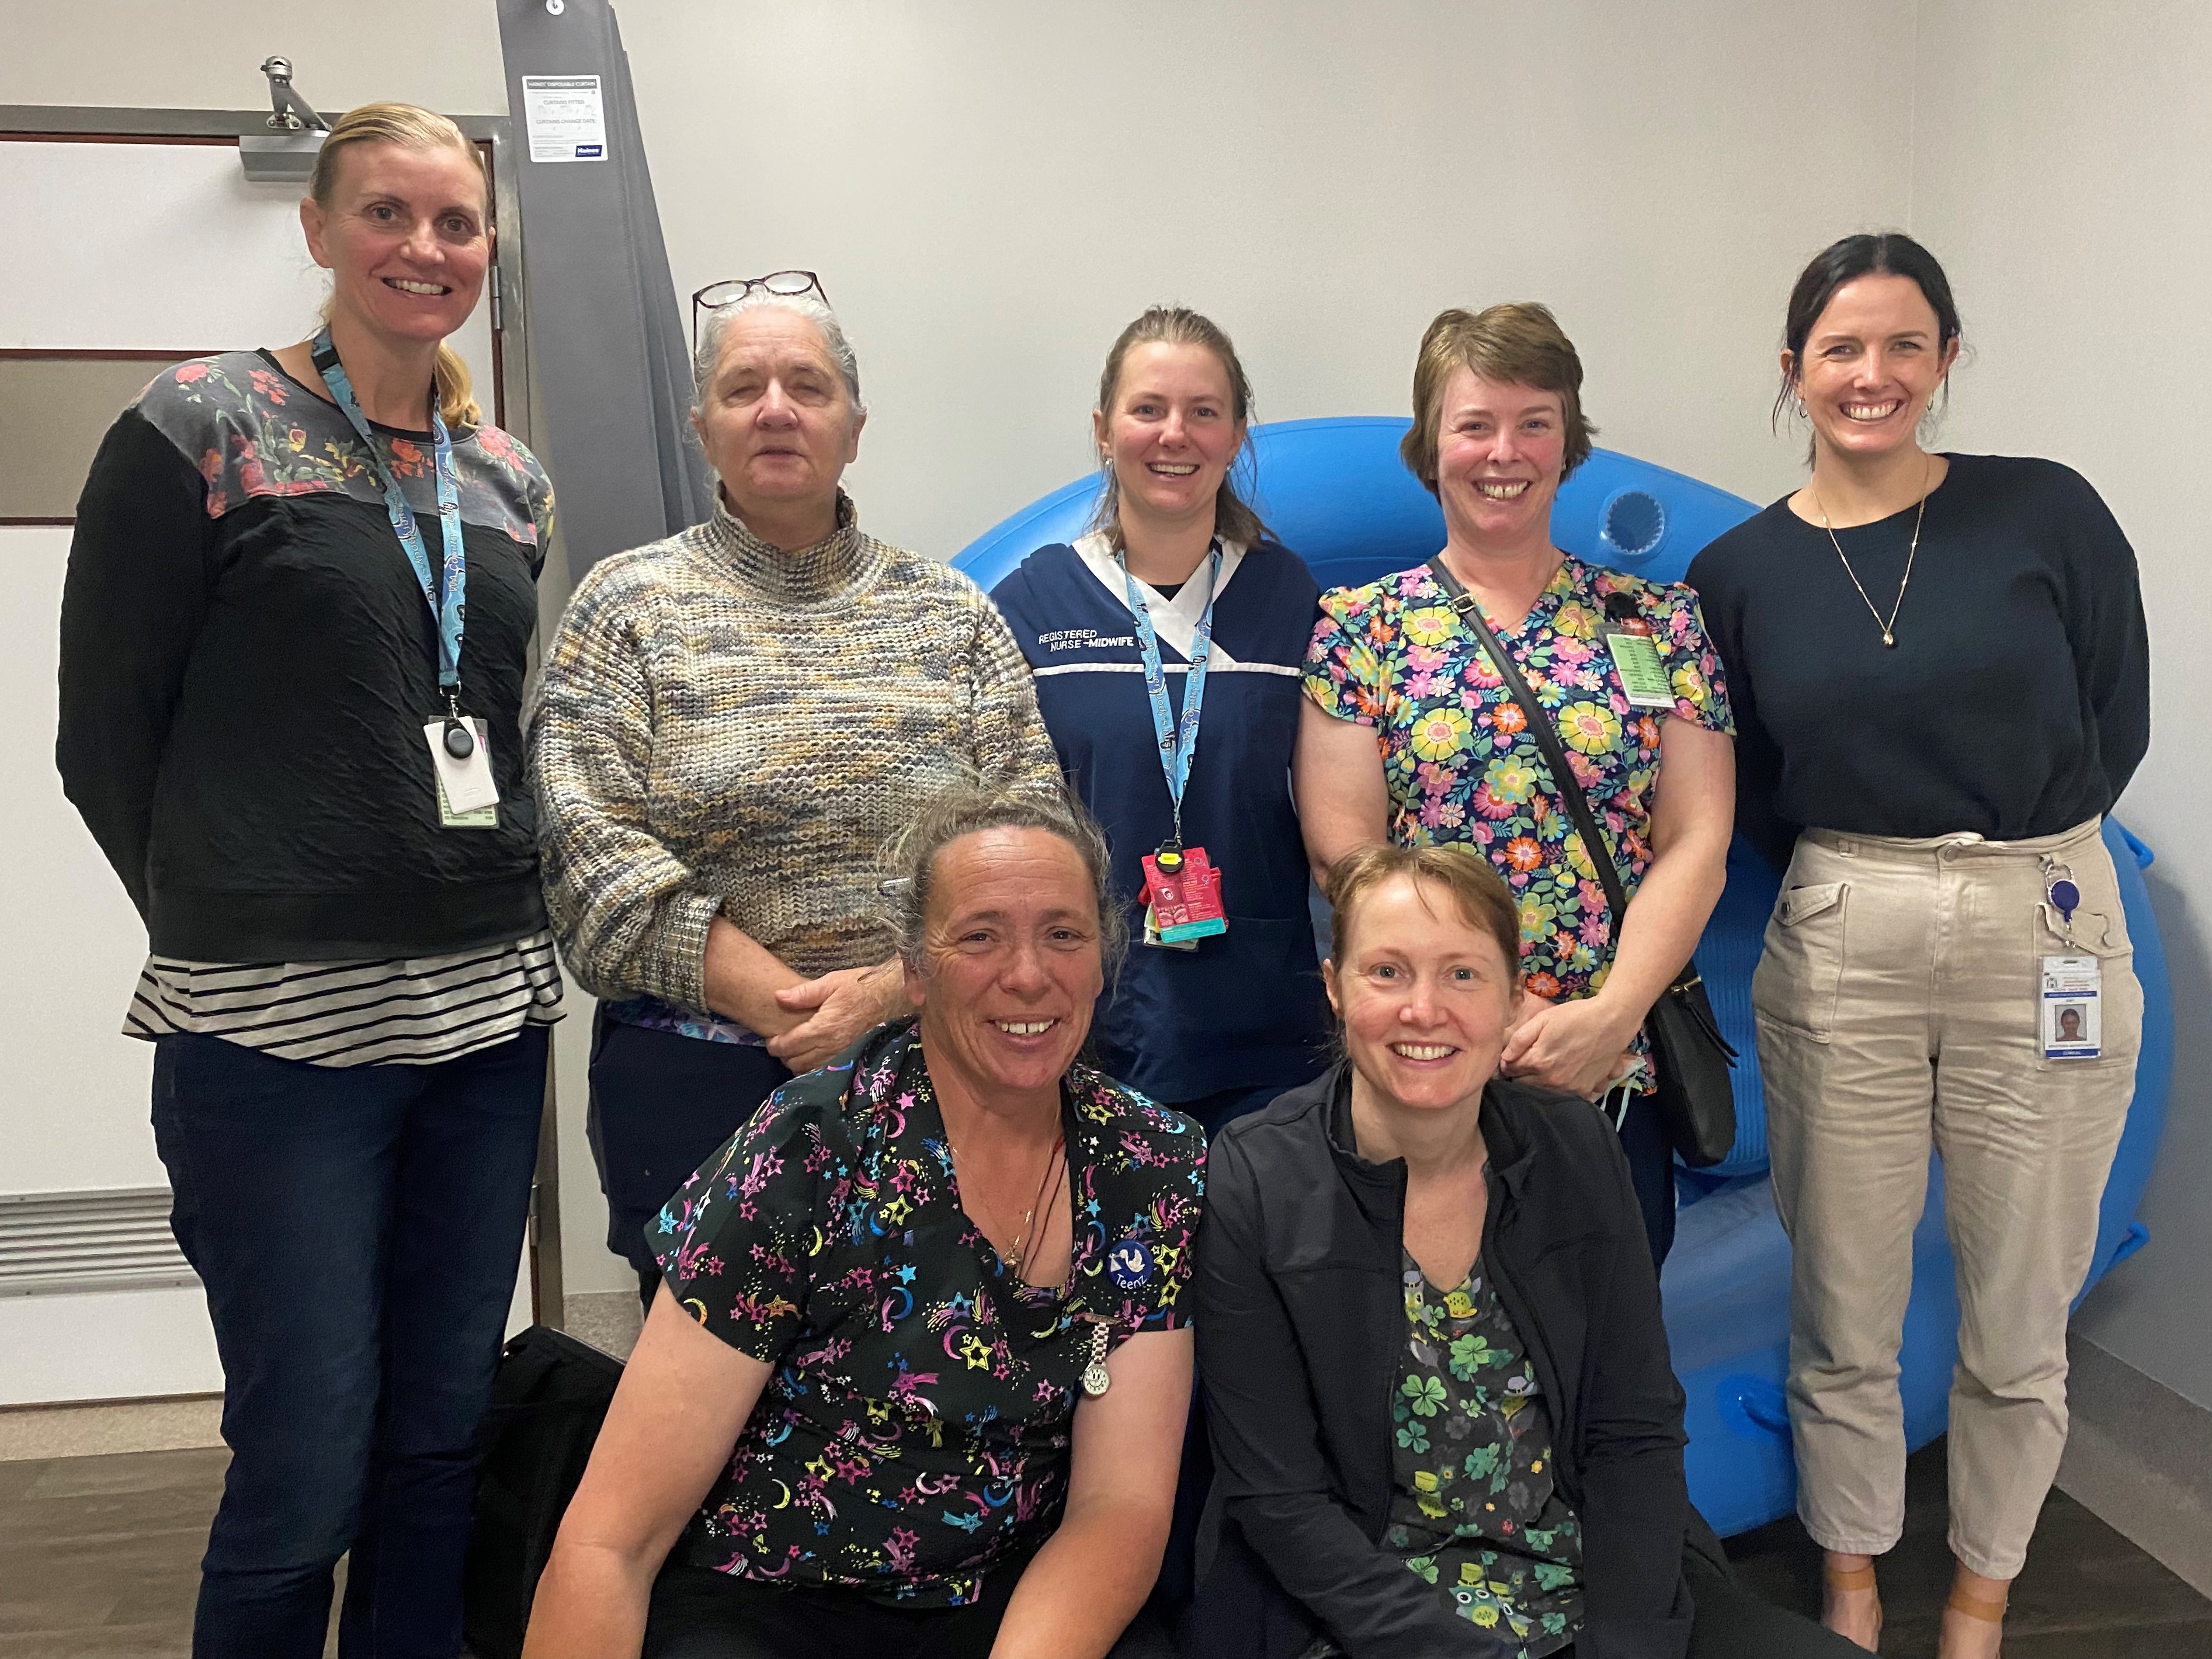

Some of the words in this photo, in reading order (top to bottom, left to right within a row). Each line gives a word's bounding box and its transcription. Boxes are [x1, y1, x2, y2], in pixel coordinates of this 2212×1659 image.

[1039, 629, 1098, 644] REGISTERED
[1185, 685, 1200, 724] Country
[1116, 1273, 1148, 1289] Teenz
